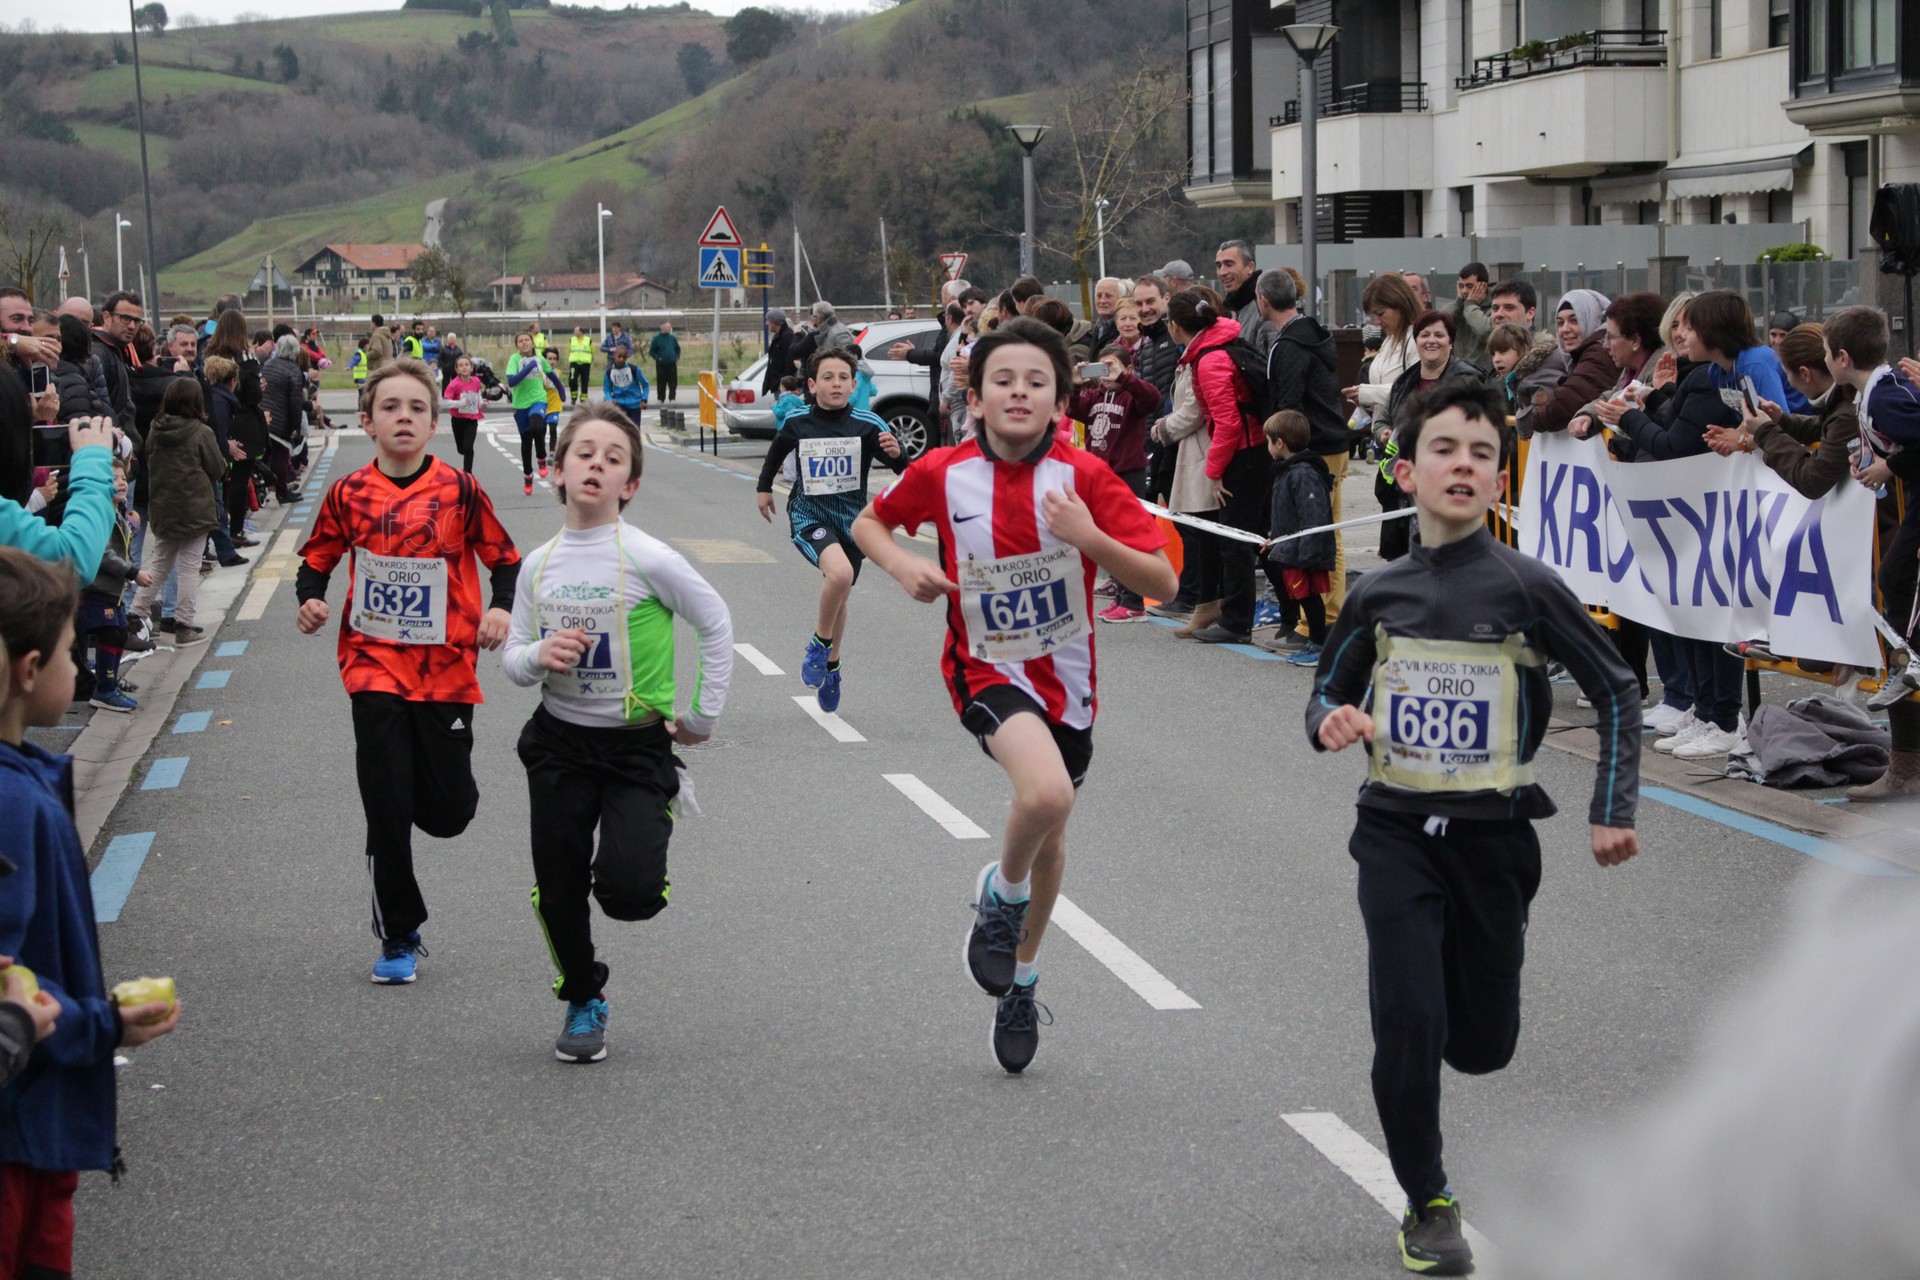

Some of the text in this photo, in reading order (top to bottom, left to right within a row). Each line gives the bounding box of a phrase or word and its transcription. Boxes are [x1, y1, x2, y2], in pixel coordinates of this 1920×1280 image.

[825, 446, 846, 456] ORIO
[812, 456, 849, 477] 700
[1536, 460, 1656, 595] KRO
[384, 561, 408, 570] KROS
[1002, 558, 1032, 572] KROS
[388, 570, 421, 584] ORIO
[1010, 567, 1051, 587] ORIO
[368, 582, 423, 617] 632
[557, 604, 581, 614] KROS
[990, 584, 1058, 631] 641
[400, 619, 430, 627] Kaiku
[561, 615, 597, 631] ORIO
[581, 671, 614, 679] Kaiku
[1424, 662, 1457, 675] KROS
[1427, 676, 1475, 697] ORIO
[1396, 696, 1478, 750] 686
[1443, 753, 1487, 764] Kaiku
